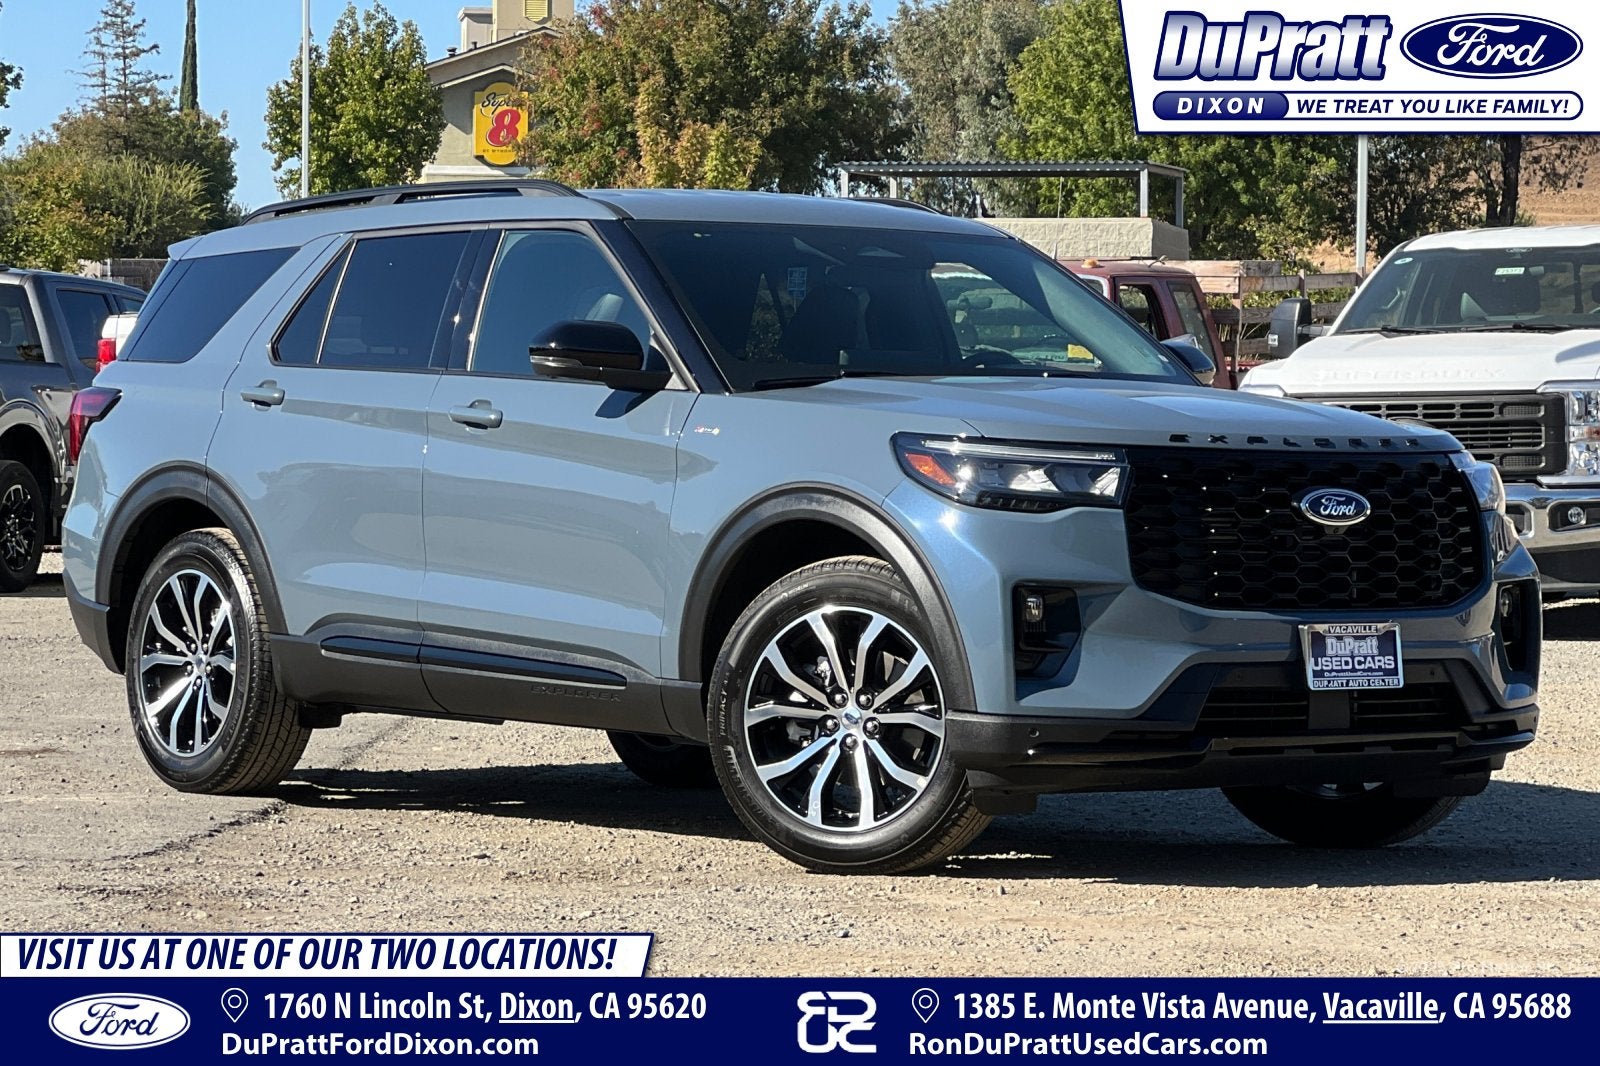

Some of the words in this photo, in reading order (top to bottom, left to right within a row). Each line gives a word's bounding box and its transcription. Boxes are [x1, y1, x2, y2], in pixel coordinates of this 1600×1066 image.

[486, 108, 521, 147] 8
[1320, 496, 1357, 517] Ford
[1329, 625, 1377, 634] VACAVILLE
[1326, 636, 1378, 656] DuPratt
[1311, 657, 1352, 670] USED
[1354, 656, 1395, 669] CARS
[1348, 679, 1369, 687] AUTO
[530, 685, 621, 702] EXPLORER
